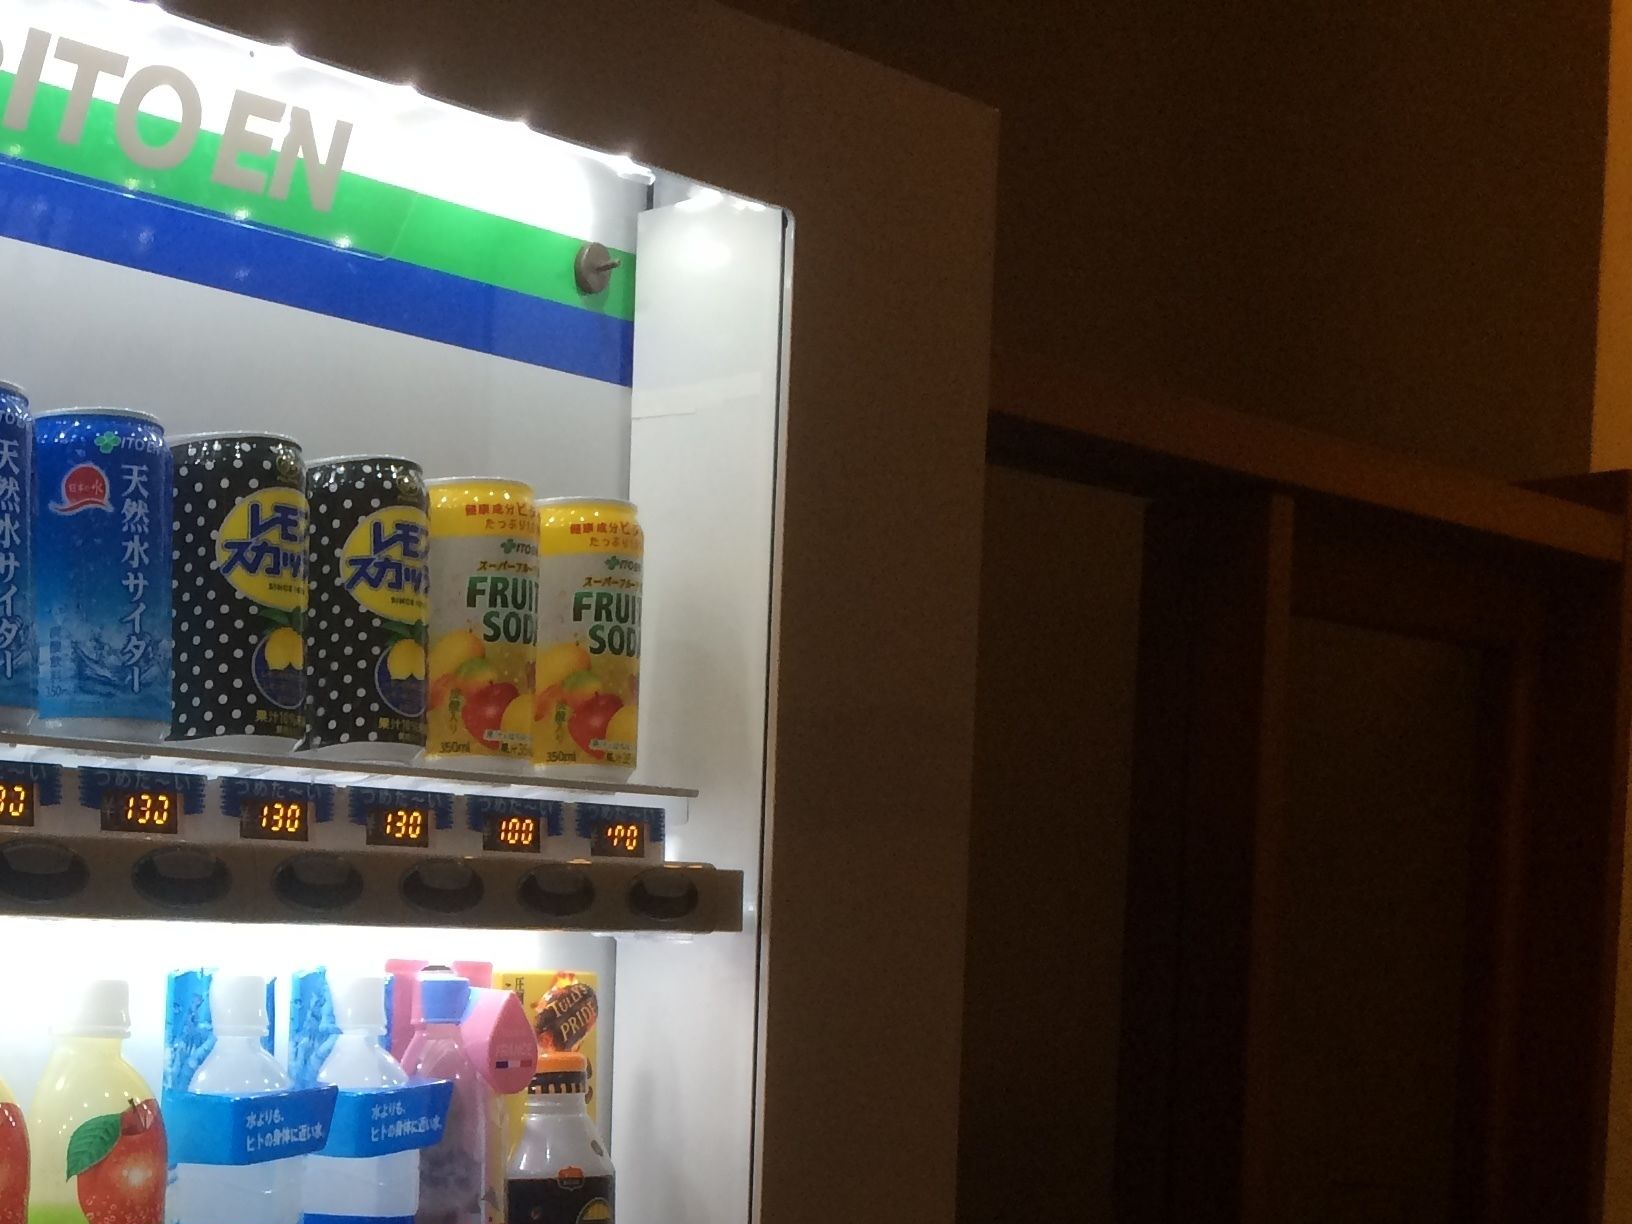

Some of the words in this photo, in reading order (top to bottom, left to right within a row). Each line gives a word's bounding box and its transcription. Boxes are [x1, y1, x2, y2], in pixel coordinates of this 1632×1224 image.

[2, 28, 202, 169] ITO
[212, 90, 353, 212] EN
[119, 463, 151, 694] 天然水サイダー
[259, 800, 303, 834] 130
[383, 808, 424, 841] 130
[498, 815, 535, 847] 100
[560, 1000, 596, 1042] PRIDE
